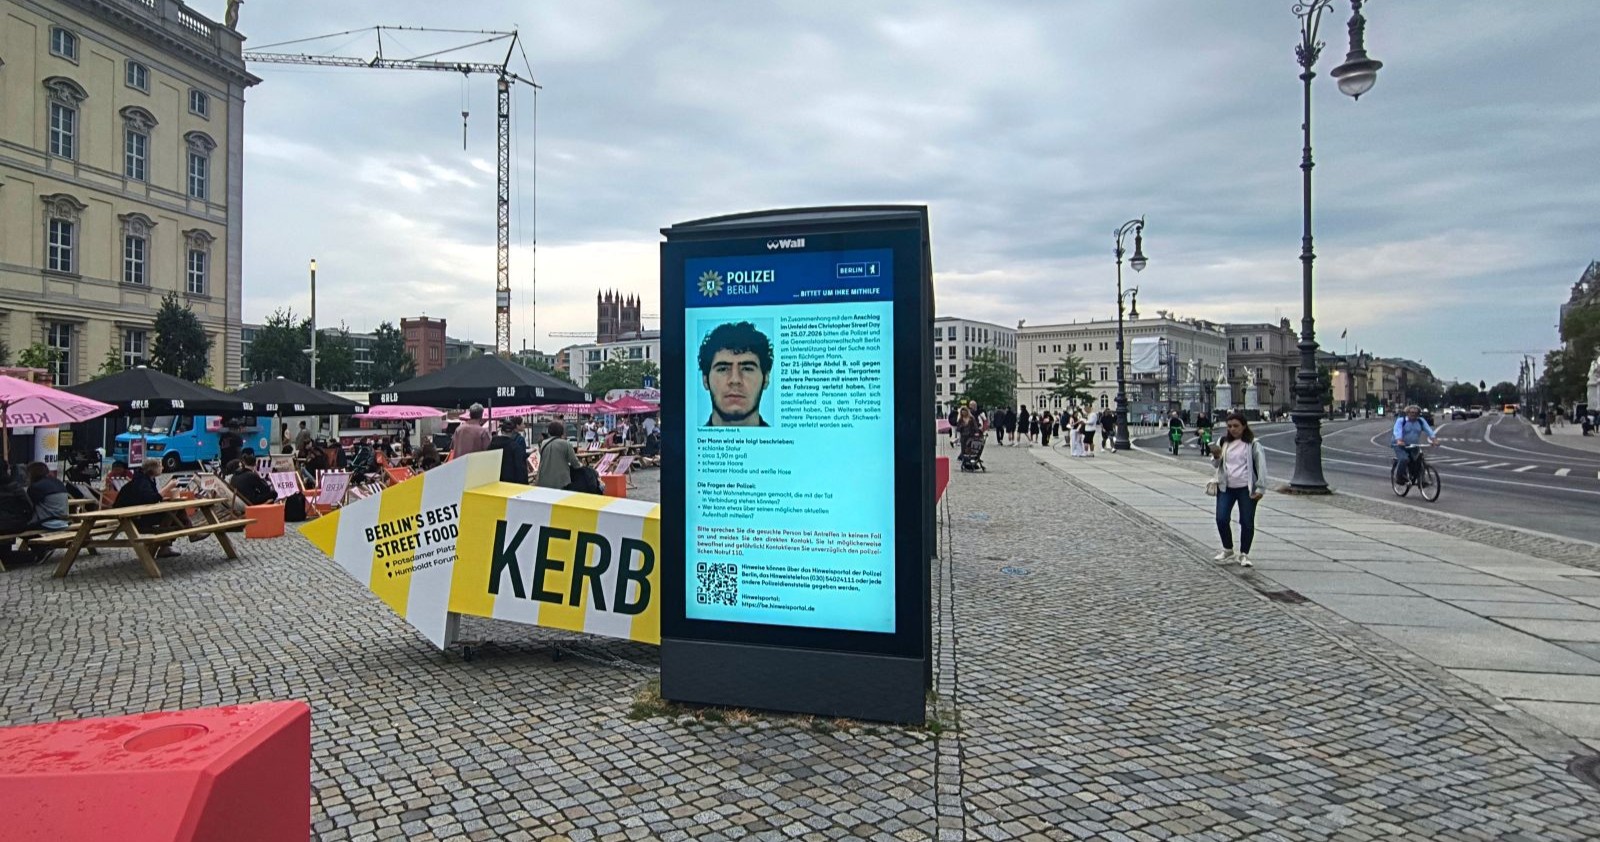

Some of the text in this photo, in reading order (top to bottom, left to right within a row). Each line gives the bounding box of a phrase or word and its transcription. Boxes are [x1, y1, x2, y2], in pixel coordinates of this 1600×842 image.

[779, 238, 805, 248] Wall
[727, 270, 774, 284] POLIZEI
[727, 285, 759, 295] BERLIN
[723, 490, 766, 498] Wahrnehmungen
[365, 504, 459, 542] BERLIN'S BEST
[375, 524, 459, 558] STREET FOOD
[837, 539, 881, 548] möglicherweise
[393, 544, 456, 566] Potsdamer Platz
[811, 546, 846, 554] unverzüglich
[395, 554, 459, 576] Humboldt Forum
[488, 520, 655, 615] KERB
[812, 567, 850, 576] Hinweisportal
[812, 582, 836, 590] gegeben
